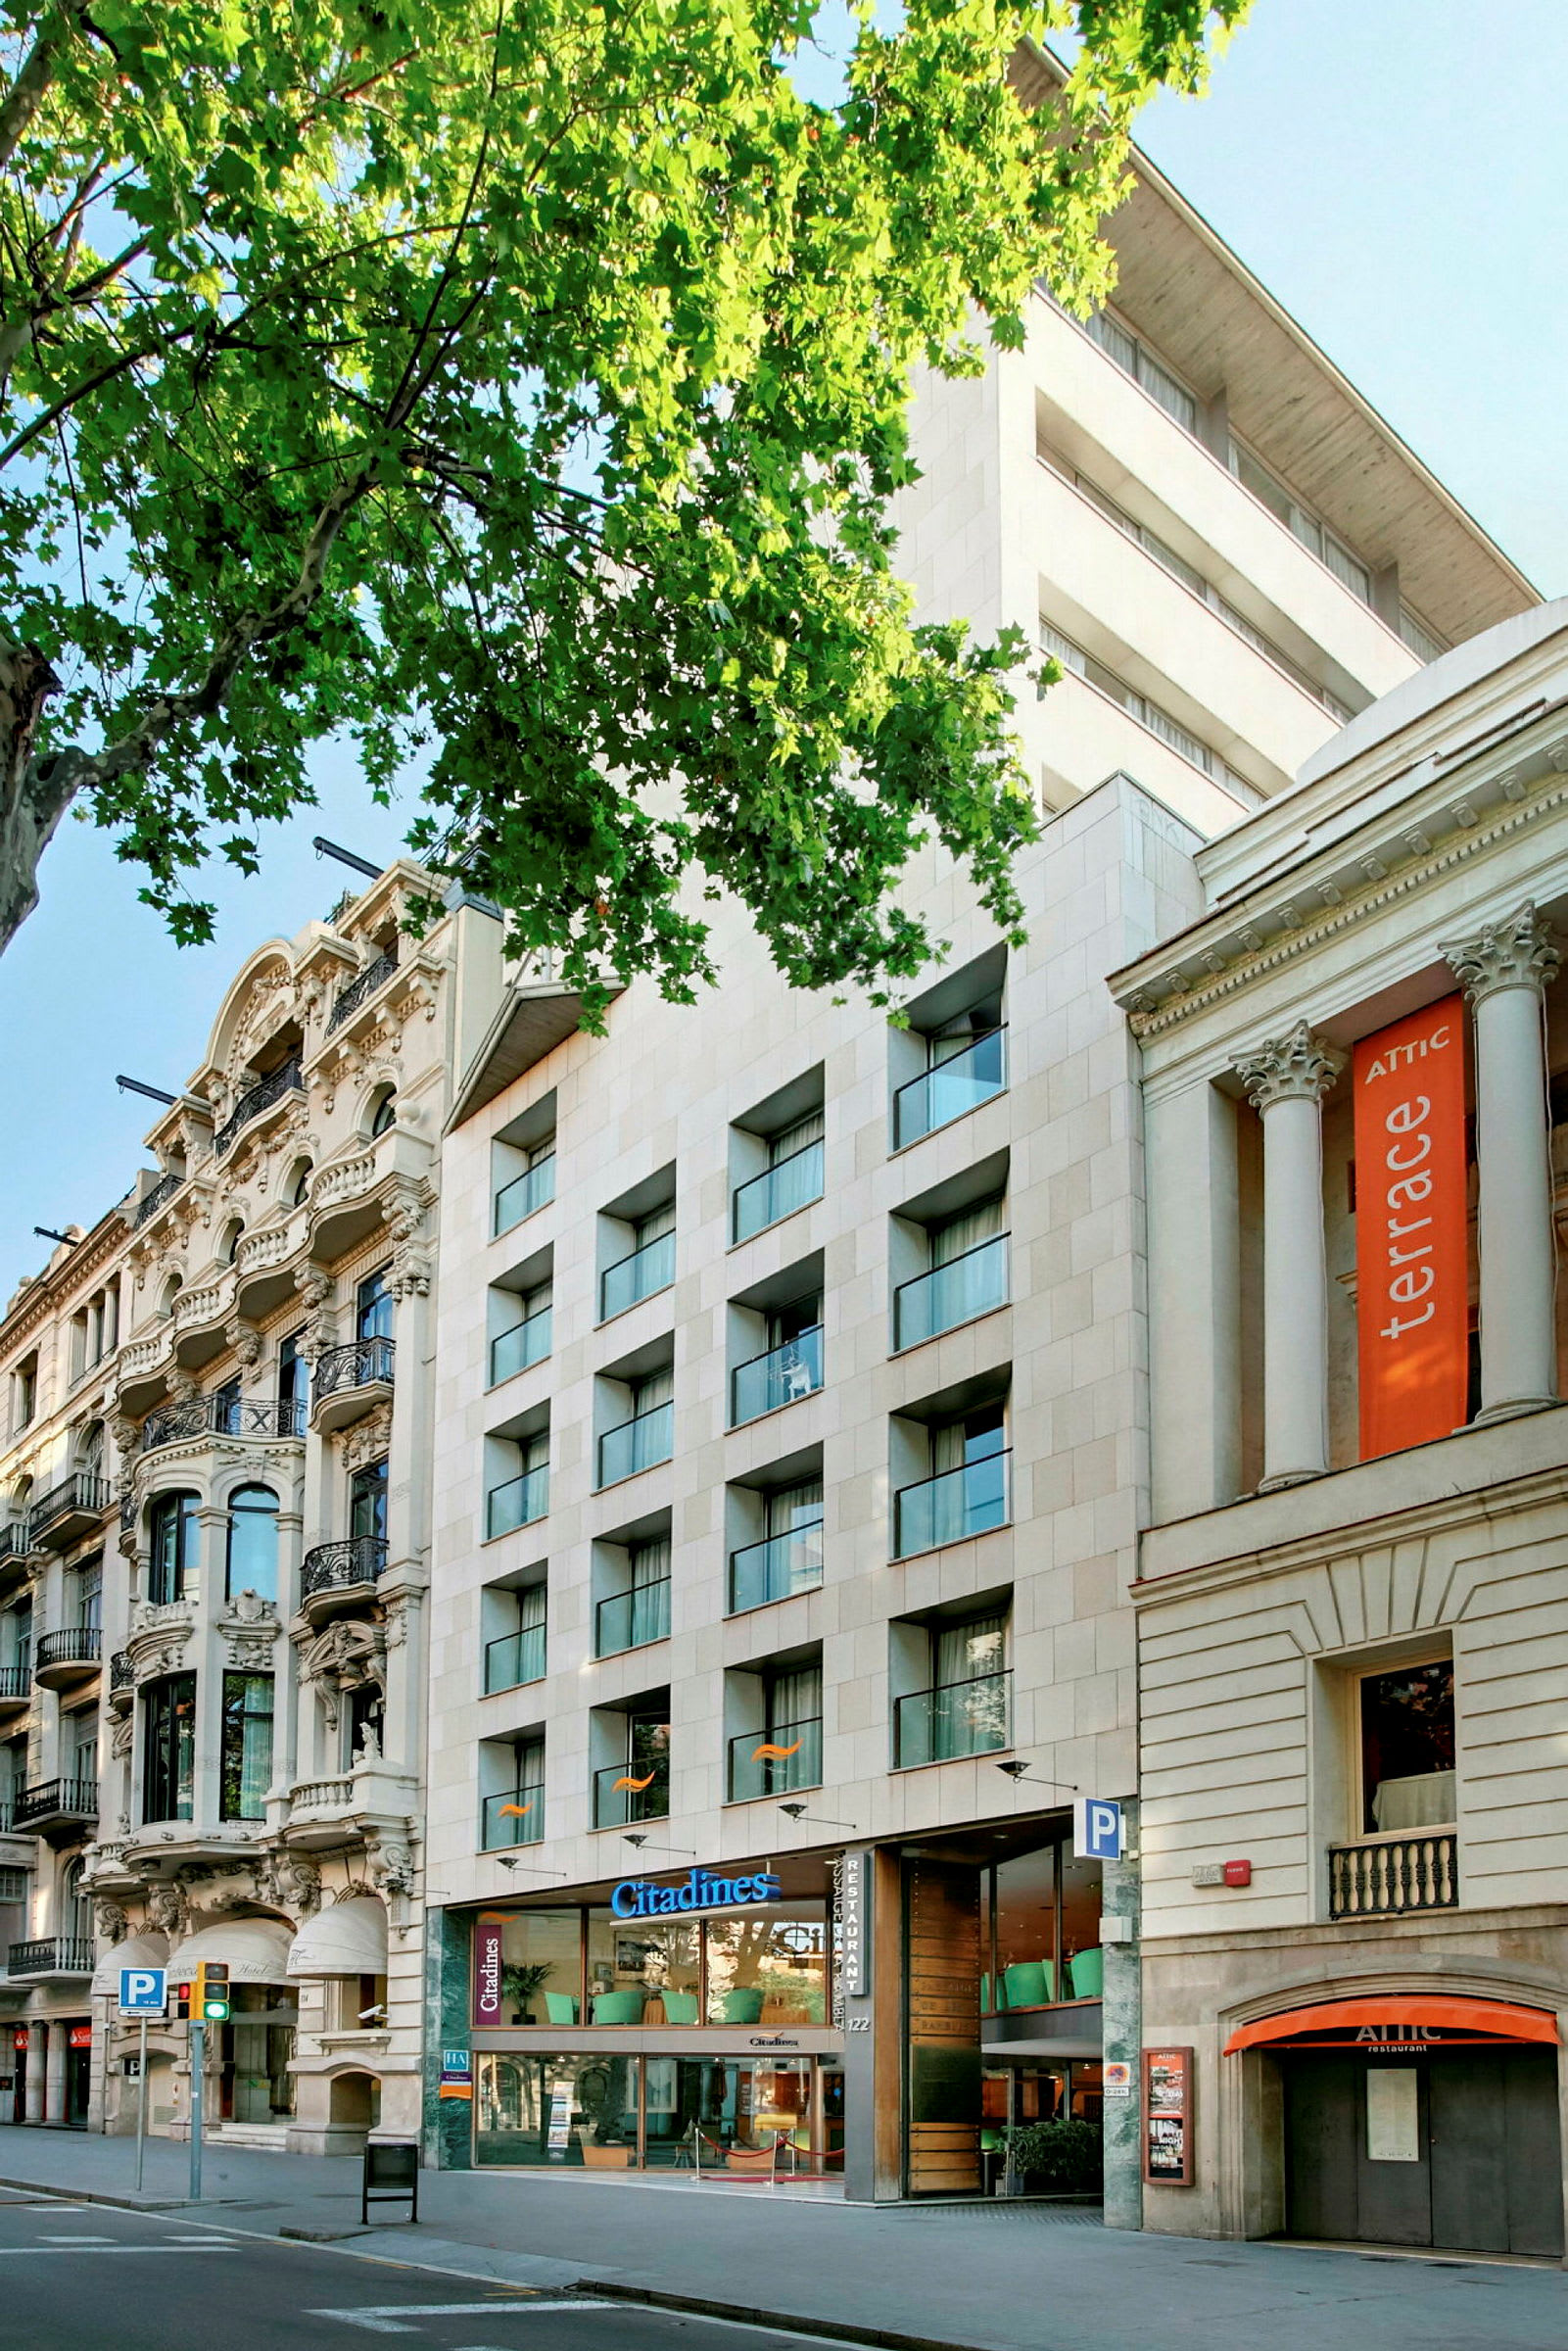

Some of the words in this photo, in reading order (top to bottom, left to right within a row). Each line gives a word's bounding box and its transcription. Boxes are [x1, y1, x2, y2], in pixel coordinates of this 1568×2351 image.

[1364, 1026, 1450, 1085] ATTIC
[1380, 1095, 1435, 1339] terrace
[1092, 1805, 1116, 1850] P
[611, 1868, 780, 1918] Citadines
[847, 1860, 858, 1991] RESTAURANT
[128, 1973, 156, 2004] P
[480, 1938, 499, 2012] Citadines
[749, 2038, 798, 2047] Citadines
[847, 2018, 870, 2032] 122
[1367, 2043, 1427, 2052] restaurant
